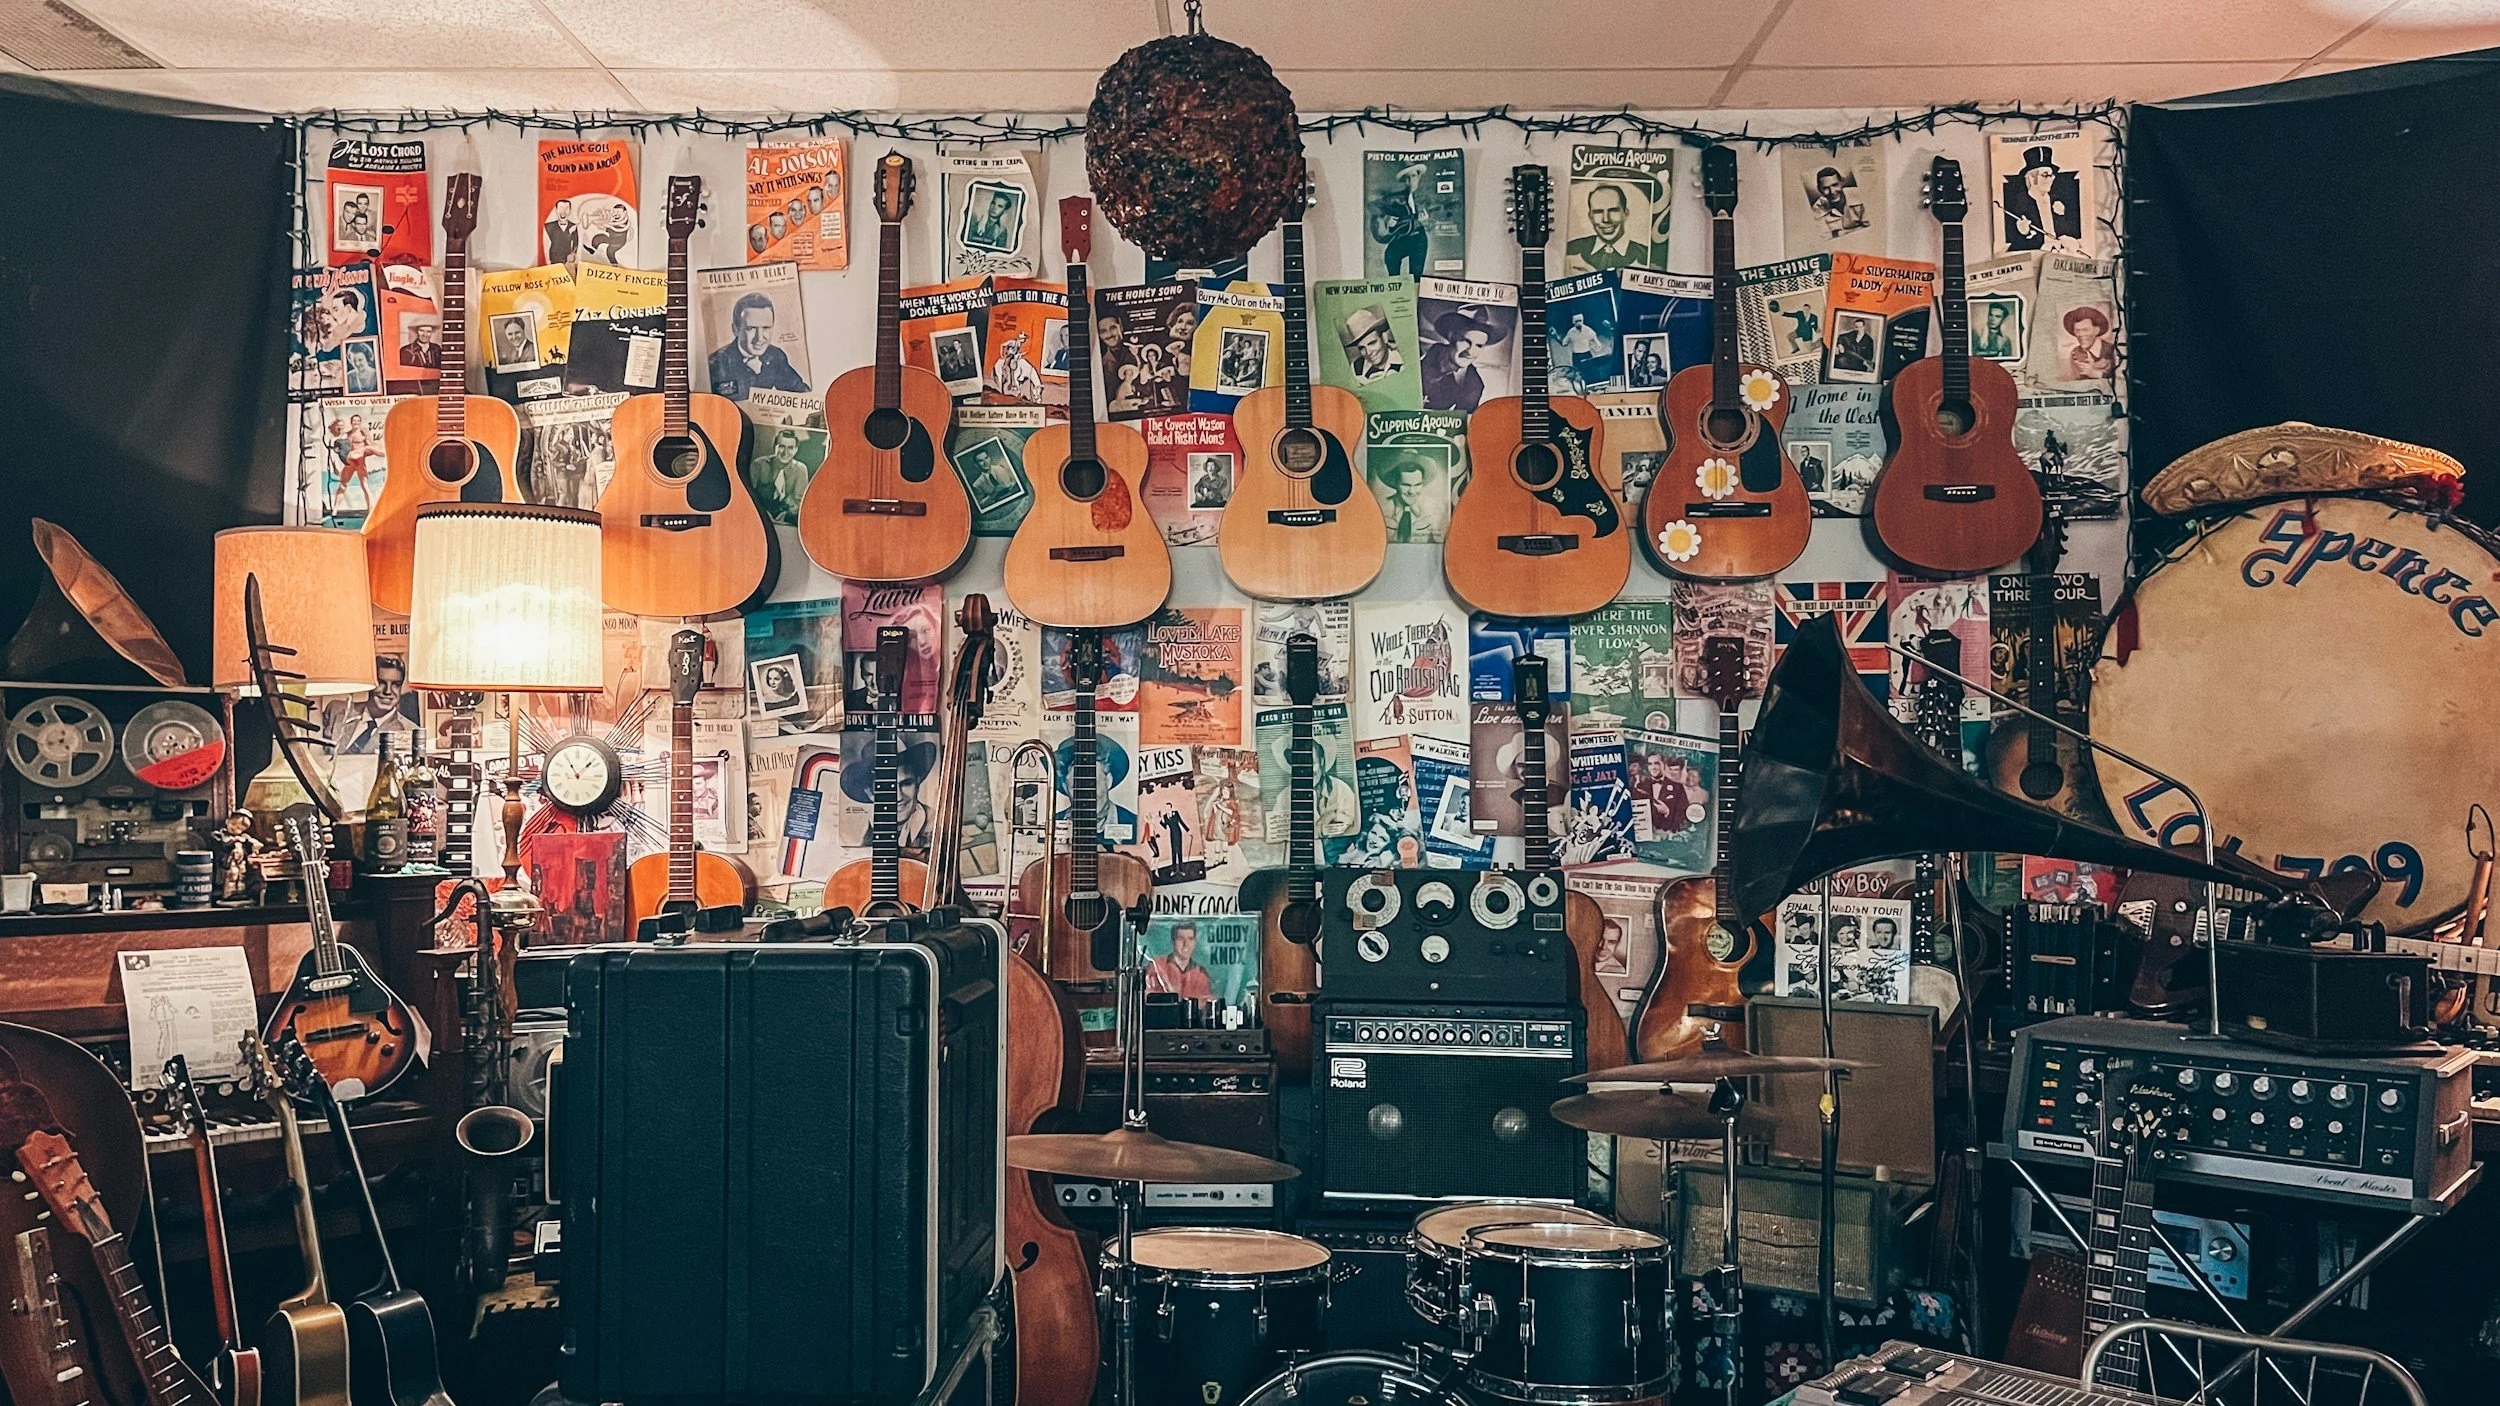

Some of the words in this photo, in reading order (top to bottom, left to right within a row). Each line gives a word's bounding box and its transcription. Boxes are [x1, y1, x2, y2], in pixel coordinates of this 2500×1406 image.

[332, 139, 361, 160] The
[362, 143, 388, 157] LOST
[390, 145, 422, 157] CHORD
[541, 150, 556, 162] THE
[557, 144, 585, 156] MUSIC
[1367, 153, 1396, 161] PISTOL
[1434, 150, 1459, 159] MAMA
[1573, 145, 1624, 170] SLIPPING
[1625, 149, 1667, 165] AROUND
[579, 162, 595, 172] AND
[747, 157, 769, 175] AL
[776, 148, 839, 175] JOLSON
[587, 268, 621, 281] DIZZY
[624, 274, 668, 287] FINGERS
[764, 266, 787, 278] HEART
[1740, 270, 1766, 282] THE
[1770, 257, 1821, 276] THING
[491, 283, 521, 293] YELLOW
[524, 281, 543, 290] ROSE
[550, 276, 571, 285] TEXAS
[1325, 286, 1340, 295] NEW
[1342, 285, 1368, 294] SPANISH
[1369, 284, 1384, 293] TWO
[1388, 282, 1402, 292] STEP
[1433, 282, 1443, 292] NO
[1447, 283, 1461, 294] ONE
[1464, 284, 1474, 296] TO
[1476, 286, 1490, 298] CRY
[1493, 287, 1504, 299] TO
[1550, 283, 1575, 299] LOUIS
[1577, 273, 1603, 292] BLUES
[1630, 274, 1639, 283] MY
[1643, 275, 1664, 287] BABY'S
[1693, 281, 1712, 291] HOME
[1851, 279, 1883, 291] DADDY
[929, 296, 946, 305] THE
[979, 287, 993, 298] ALL
[996, 291, 1021, 303] HOME
[1025, 291, 1038, 301] ON
[1042, 292, 1058, 304] THE
[1105, 292, 1124, 302] THE
[1126, 287, 1155, 300] HONEY
[1158, 285, 1183, 297] SONG
[1199, 290, 1216, 304] Bury
[1217, 294, 1229, 305] Me
[1231, 296, 1246, 307] Out
[1248, 300, 1258, 308] on
[1259, 298, 1272, 309] the
[910, 304, 938, 318] DONE
[940, 303, 964, 314] THIS
[966, 298, 987, 310] FALL
[349, 398, 367, 406] YOU
[752, 392, 766, 404] MY
[766, 394, 798, 409] ADOBE
[1806, 389, 1848, 408] Home
[1857, 387, 1872, 402] in
[1147, 418, 1163, 431] The
[1165, 417, 1196, 431] Covered
[1198, 417, 1226, 431] Wagon
[1819, 407, 1840, 424] the
[1846, 407, 1880, 424] West
[1369, 414, 1420, 439] SLIPPING
[1421, 413, 1463, 431] AROUND
[1148, 431, 1173, 445] Rolled
[1174, 430, 1198, 445] Right
[1200, 431, 1225, 446] Along
[2241, 508, 2500, 637] Spence
[1793, 602, 1803, 610] THE
[1000, 608, 1031, 631] WIFE
[1630, 610, 1654, 621] THE
[373, 624, 387, 635] THE
[618, 618, 638, 631] MOON
[1148, 620, 1200, 643] LOVELY
[1199, 620, 1241, 643] LAKE
[1260, 626, 1278, 638] WITH
[1279, 629, 1287, 639] A
[1570, 625, 1604, 635] RIVER
[1608, 624, 1667, 635] SHANNON
[1371, 631, 1404, 658] WHILE
[1599, 637, 1642, 649] FLOWS
[1403, 645, 1411, 659] A
[1370, 669, 1394, 703] OLD
[1396, 664, 1436, 695] BRITISH
[1437, 666, 1460, 698] RAG
[846, 714, 868, 726] ROSE
[1044, 714, 1060, 722] EACH
[1261, 713, 1278, 722] EACH
[1328, 708, 1341, 716] WAY
[1408, 708, 1453, 725] SUTTON
[1474, 706, 1498, 724] Live
[656, 725, 668, 733] TILL
[1578, 735, 1618, 746] MONTEREY
[1679, 738, 1701, 749] BELIEVE
[1153, 749, 1184, 769] KISS
[1429, 745, 1459, 757] WALKING
[1571, 753, 1622, 769] WHITEMAN
[1594, 769, 1617, 782] JAZZ
[1787, 902, 1815, 911] FINAL
[1207, 924, 1249, 943] BUDDY
[1210, 946, 1246, 966] KNOX
[1330, 1078, 1366, 1088] Roland
[2316, 1175, 2348, 1187] Vocal
[2359, 1180, 2398, 1194] Master
